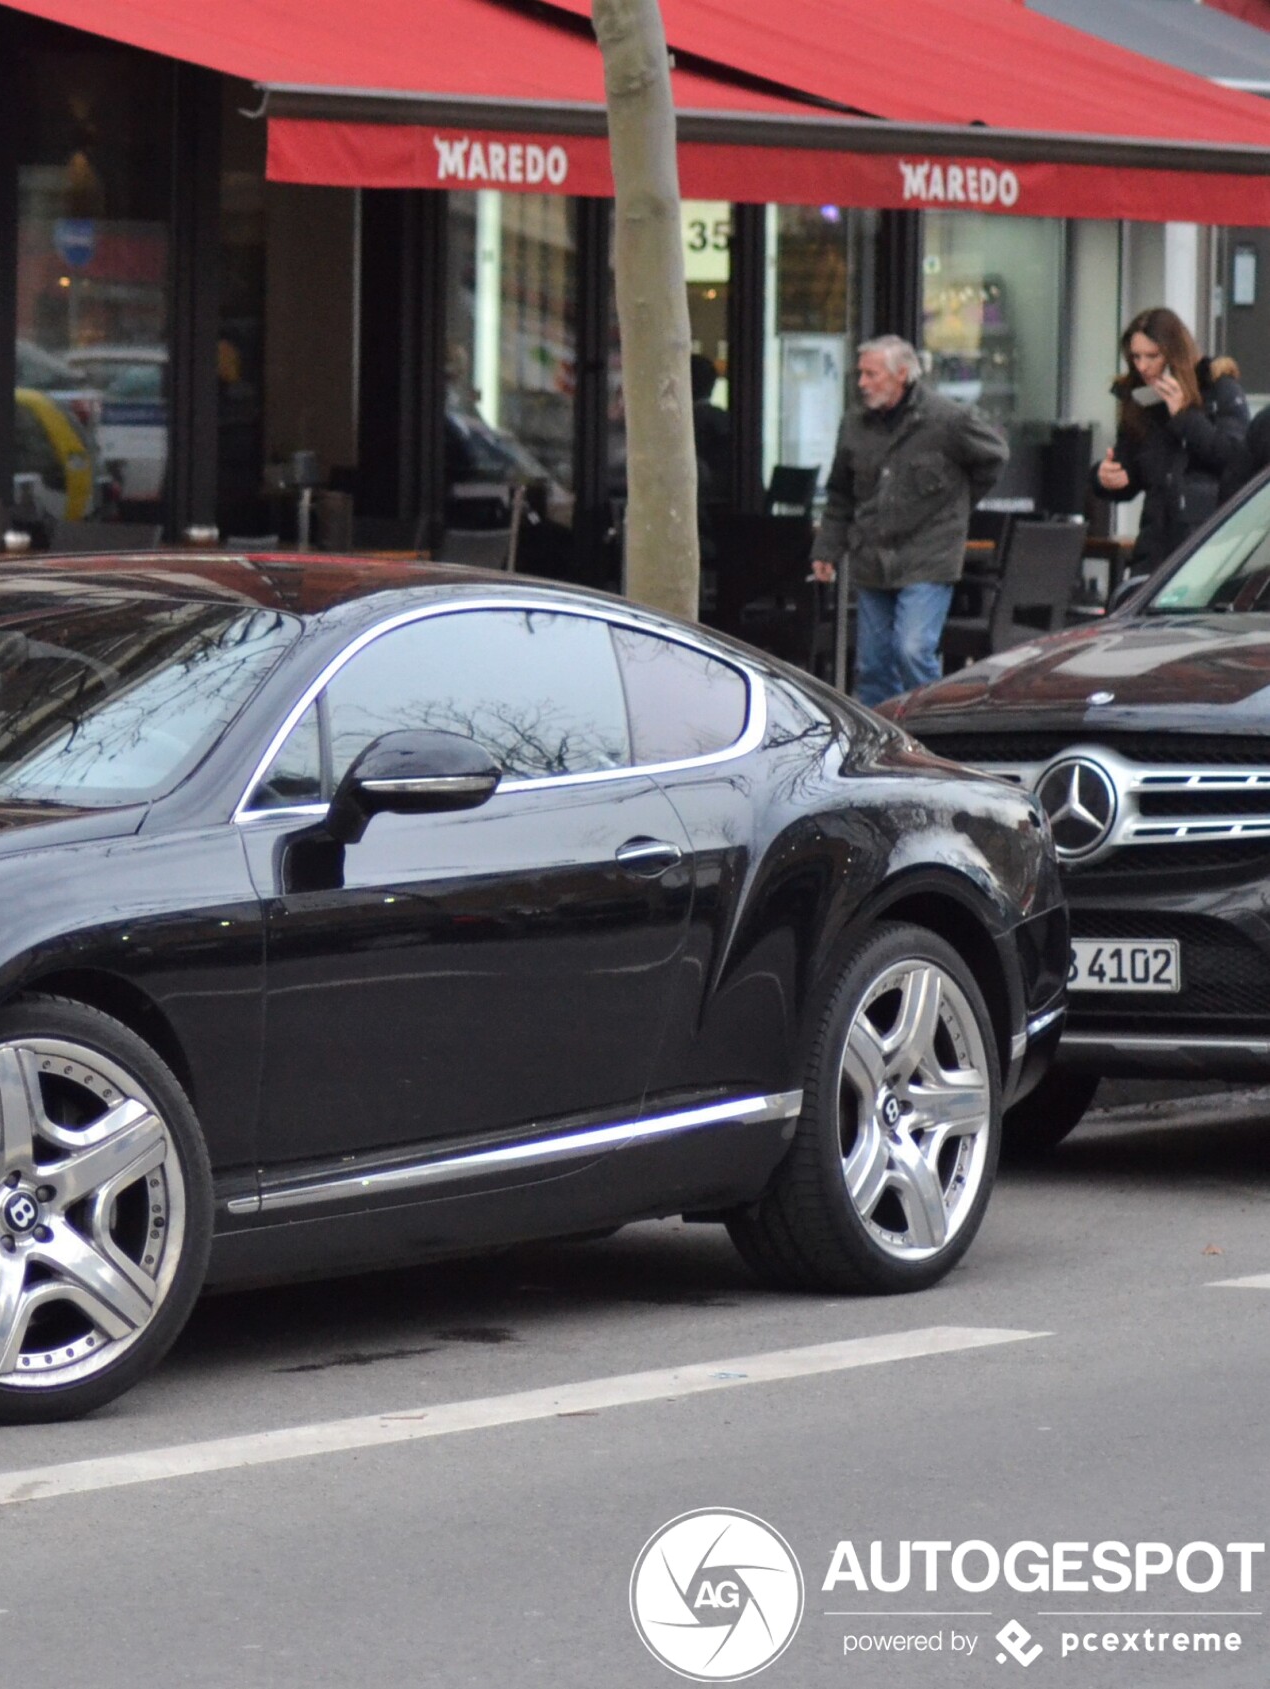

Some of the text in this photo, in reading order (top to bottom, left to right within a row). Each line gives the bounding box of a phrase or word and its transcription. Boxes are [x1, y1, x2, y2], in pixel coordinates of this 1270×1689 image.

[433, 135, 567, 184] MAREDO
[898, 158, 1020, 207] MAREDO
[688, 220, 729, 251] 35
[1088, 948, 1172, 984] 4102
